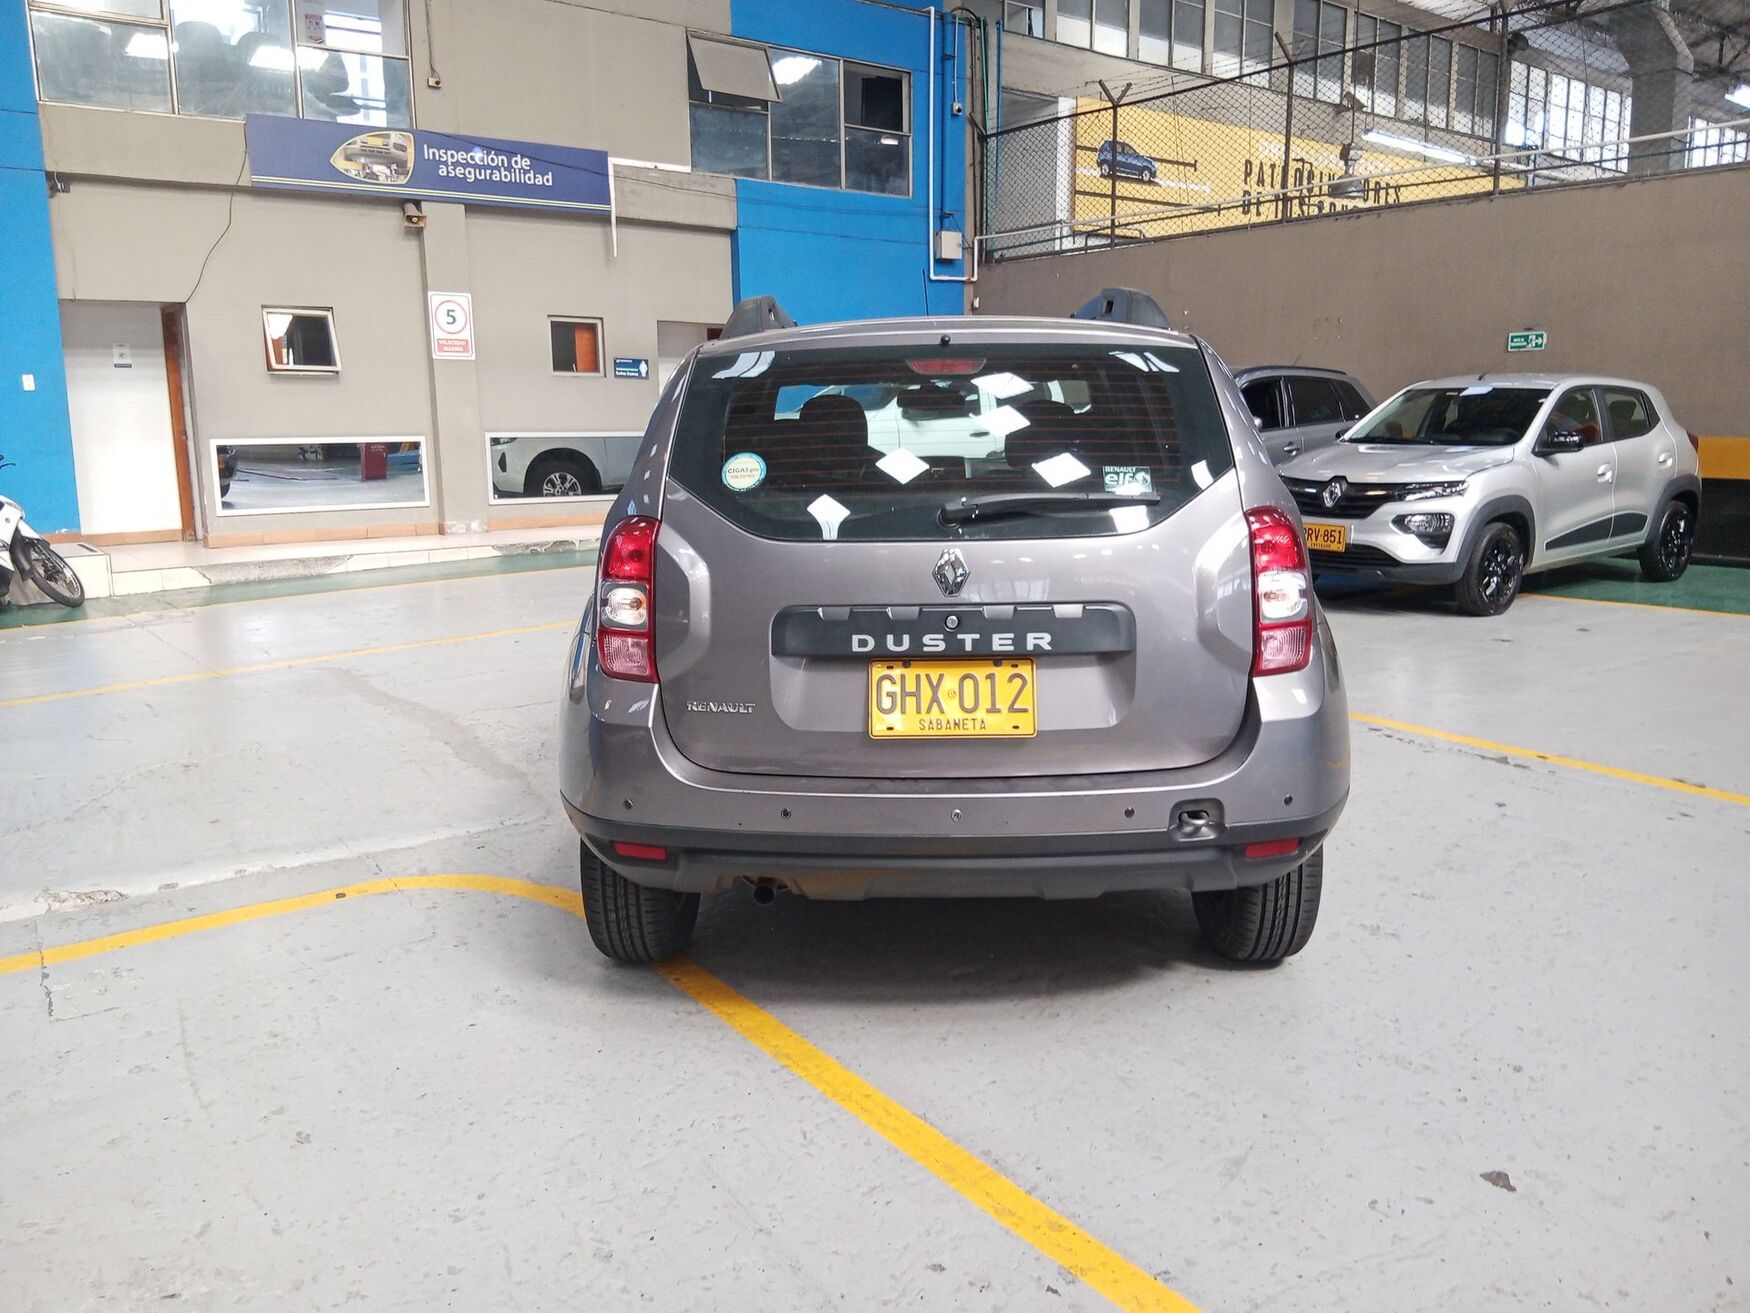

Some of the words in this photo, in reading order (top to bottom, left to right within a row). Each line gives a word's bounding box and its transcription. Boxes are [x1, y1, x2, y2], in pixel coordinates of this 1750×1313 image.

[424, 144, 508, 168] Inspección
[512, 154, 531, 170] de
[438, 164, 553, 186] asegurabilidad
[1244, 159, 1401, 204] PATOCINORES
[446, 308, 457, 325] 5
[851, 633, 1053, 652] DUSTER
[876, 673, 945, 715] GHX
[958, 672, 1029, 714] 012
[686, 701, 756, 714] RENAULT
[919, 718, 987, 731] SABANETA
